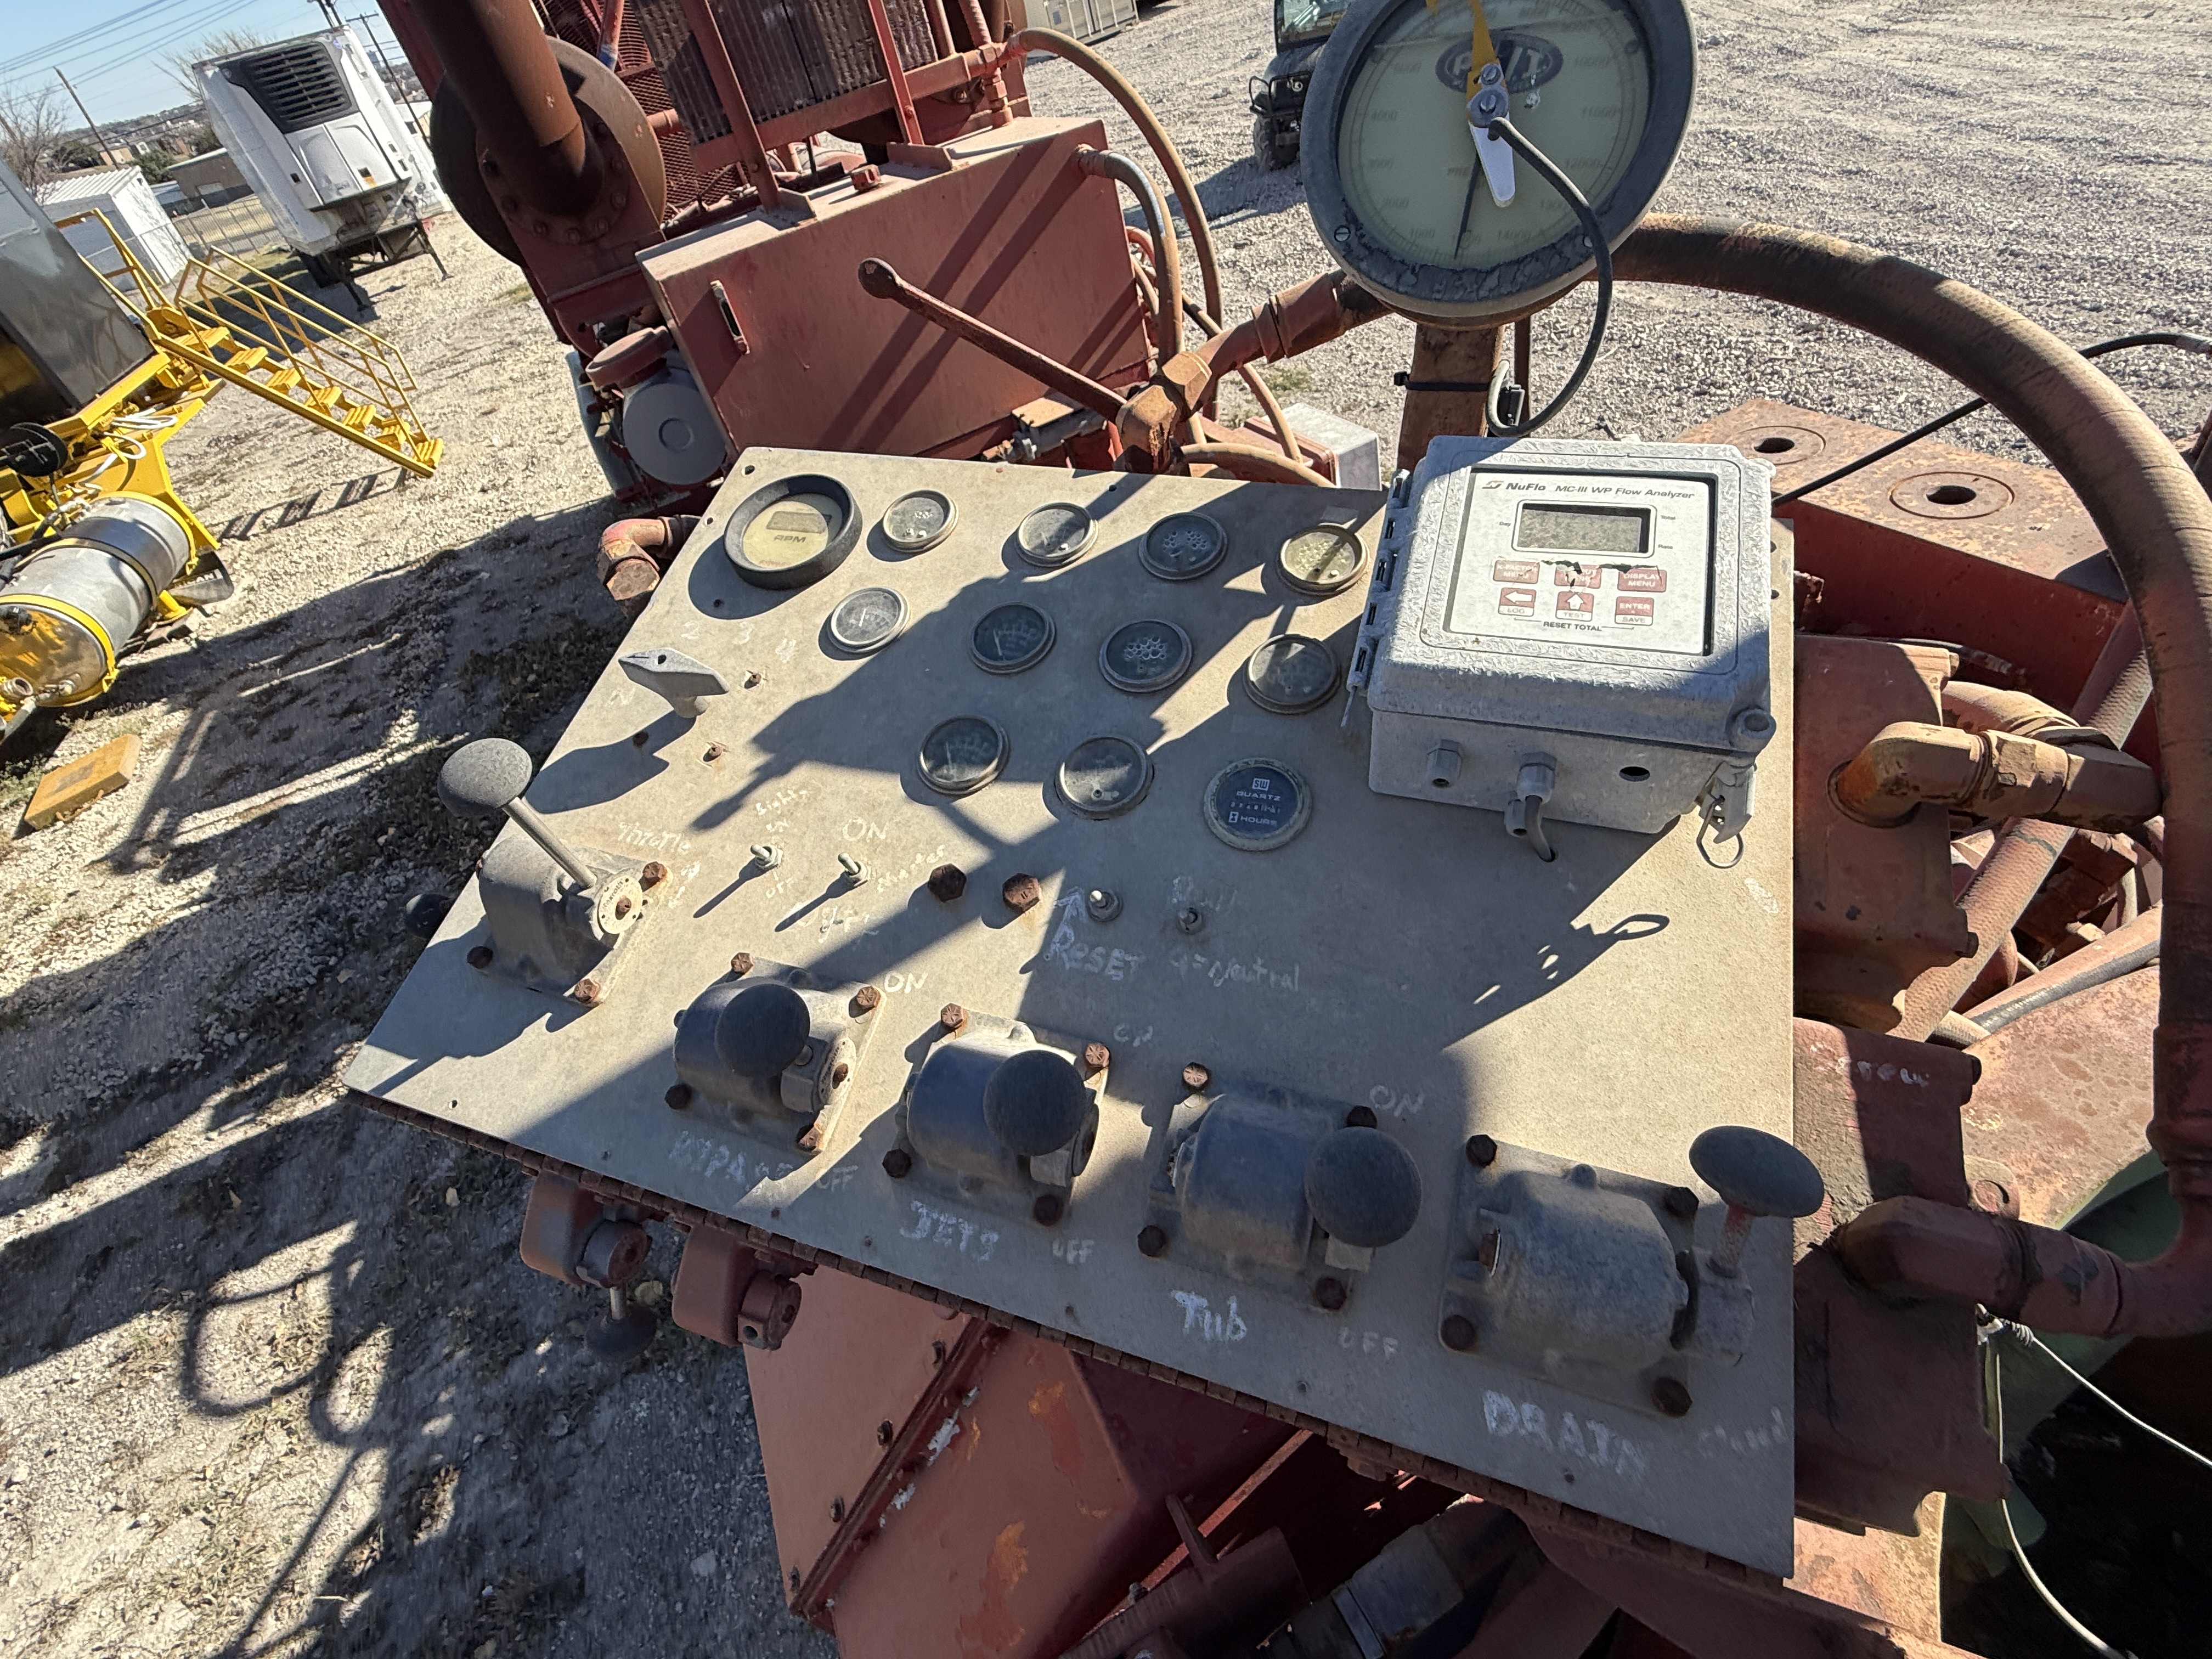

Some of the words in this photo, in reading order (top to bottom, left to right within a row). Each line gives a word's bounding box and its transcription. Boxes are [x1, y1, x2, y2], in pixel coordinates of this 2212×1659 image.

[1505, 482, 1546, 492] NuFlo
[1555, 485, 1588, 493] MC-III
[1615, 488, 1642, 496] Flow
[1645, 489, 1695, 499] Analyzer
[773, 534, 806, 544] RPM
[1627, 579, 1656, 588] MENU
[1543, 620, 1572, 630] RESET
[1236, 791, 1281, 802] QUARTZ
[1240, 815, 1278, 826] HOURS
[843, 816, 890, 842] ON
[884, 970, 929, 995] ON
[1369, 1084, 1425, 1118] ON
